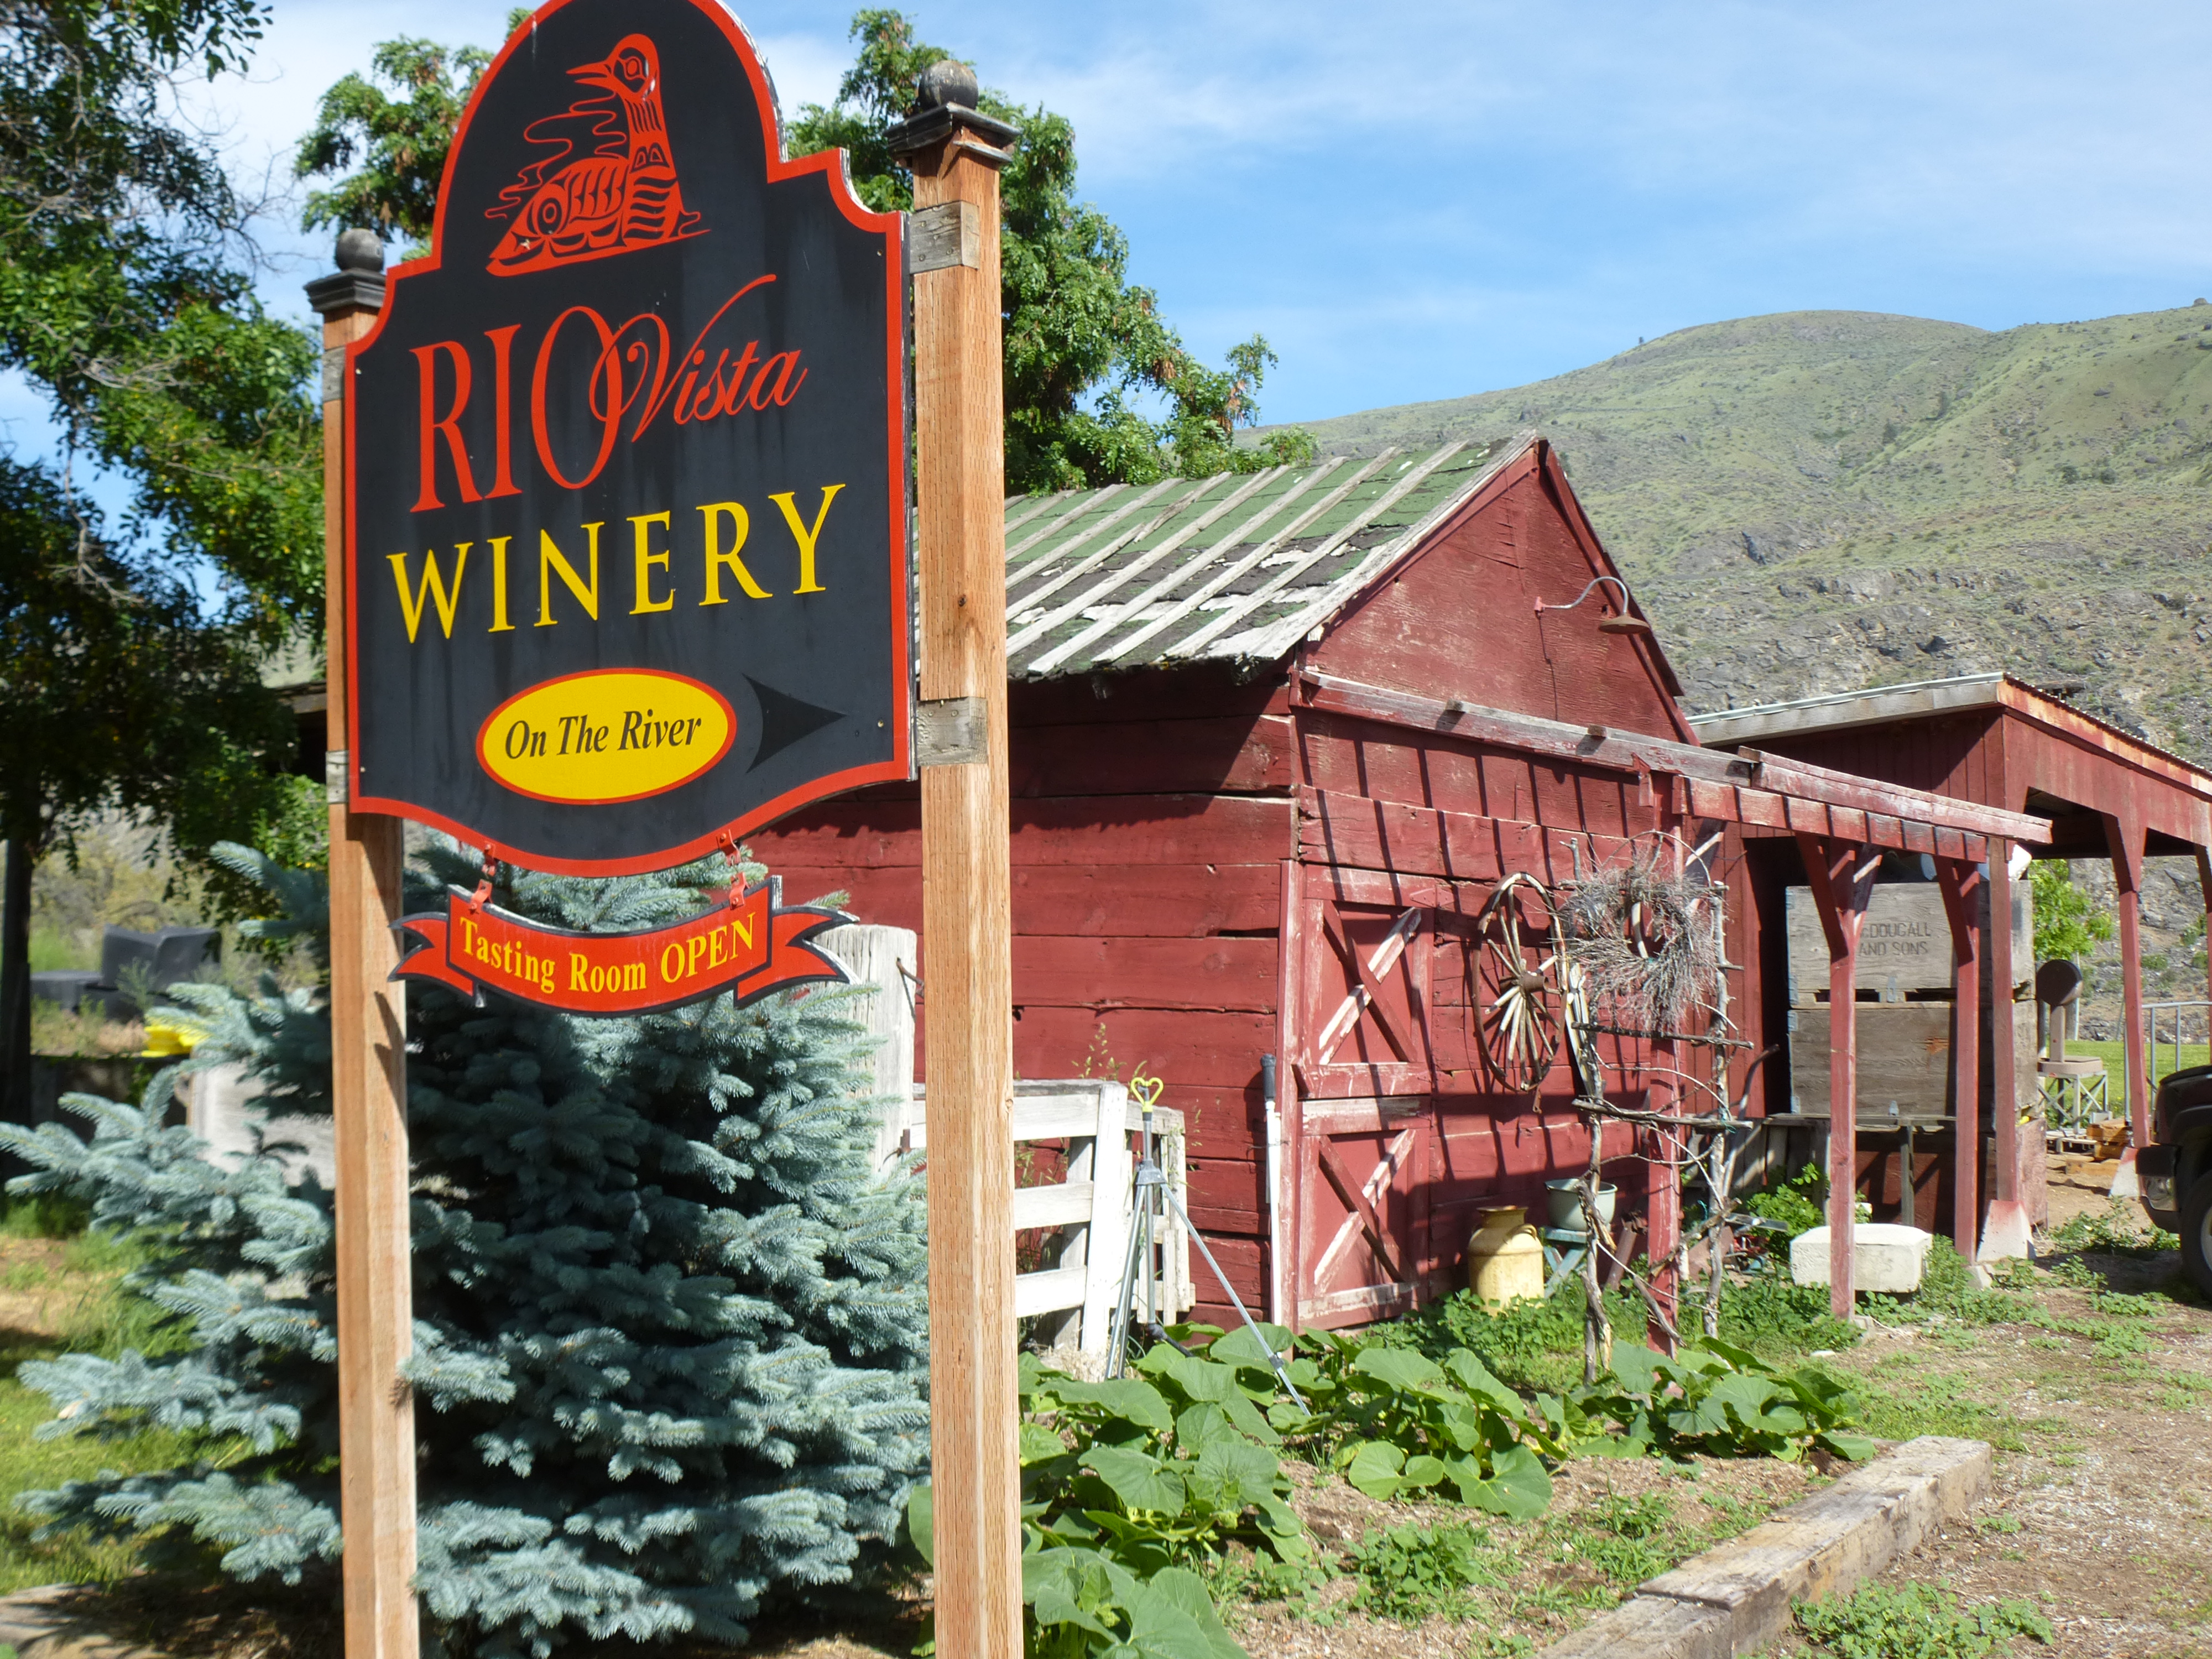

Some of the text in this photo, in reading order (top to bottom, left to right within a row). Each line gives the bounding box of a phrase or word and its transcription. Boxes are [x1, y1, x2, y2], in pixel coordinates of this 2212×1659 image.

[409, 274, 808, 512] RIO Vista
[386, 483, 846, 643] WINERY
[505, 708, 702, 759] On The River
[460, 912, 756, 994] Tasting Room OPEN
[1860, 922, 1931, 938] cDOUGALL
[1860, 941, 1928, 956] AND SONS
